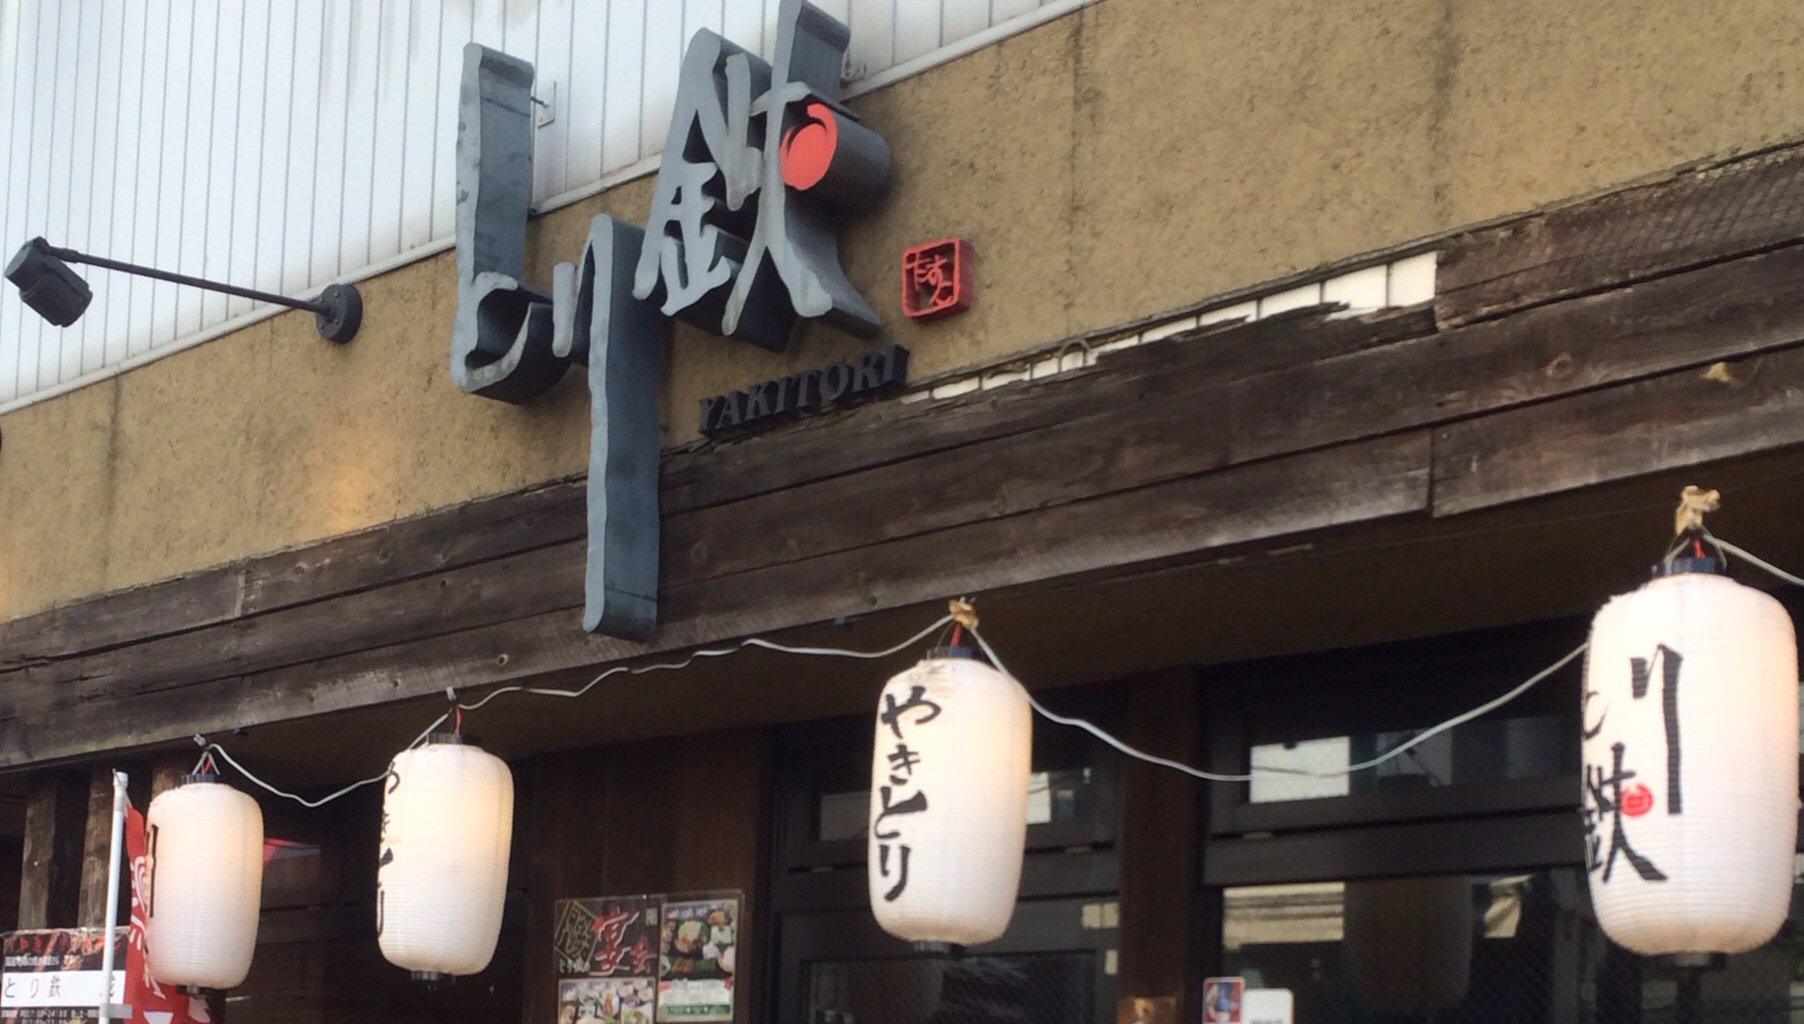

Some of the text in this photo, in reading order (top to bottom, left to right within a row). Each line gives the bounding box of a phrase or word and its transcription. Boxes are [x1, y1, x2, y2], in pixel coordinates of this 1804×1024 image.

[699, 344, 909, 432] YAKITORI
[874, 685, 942, 902] やきとり
